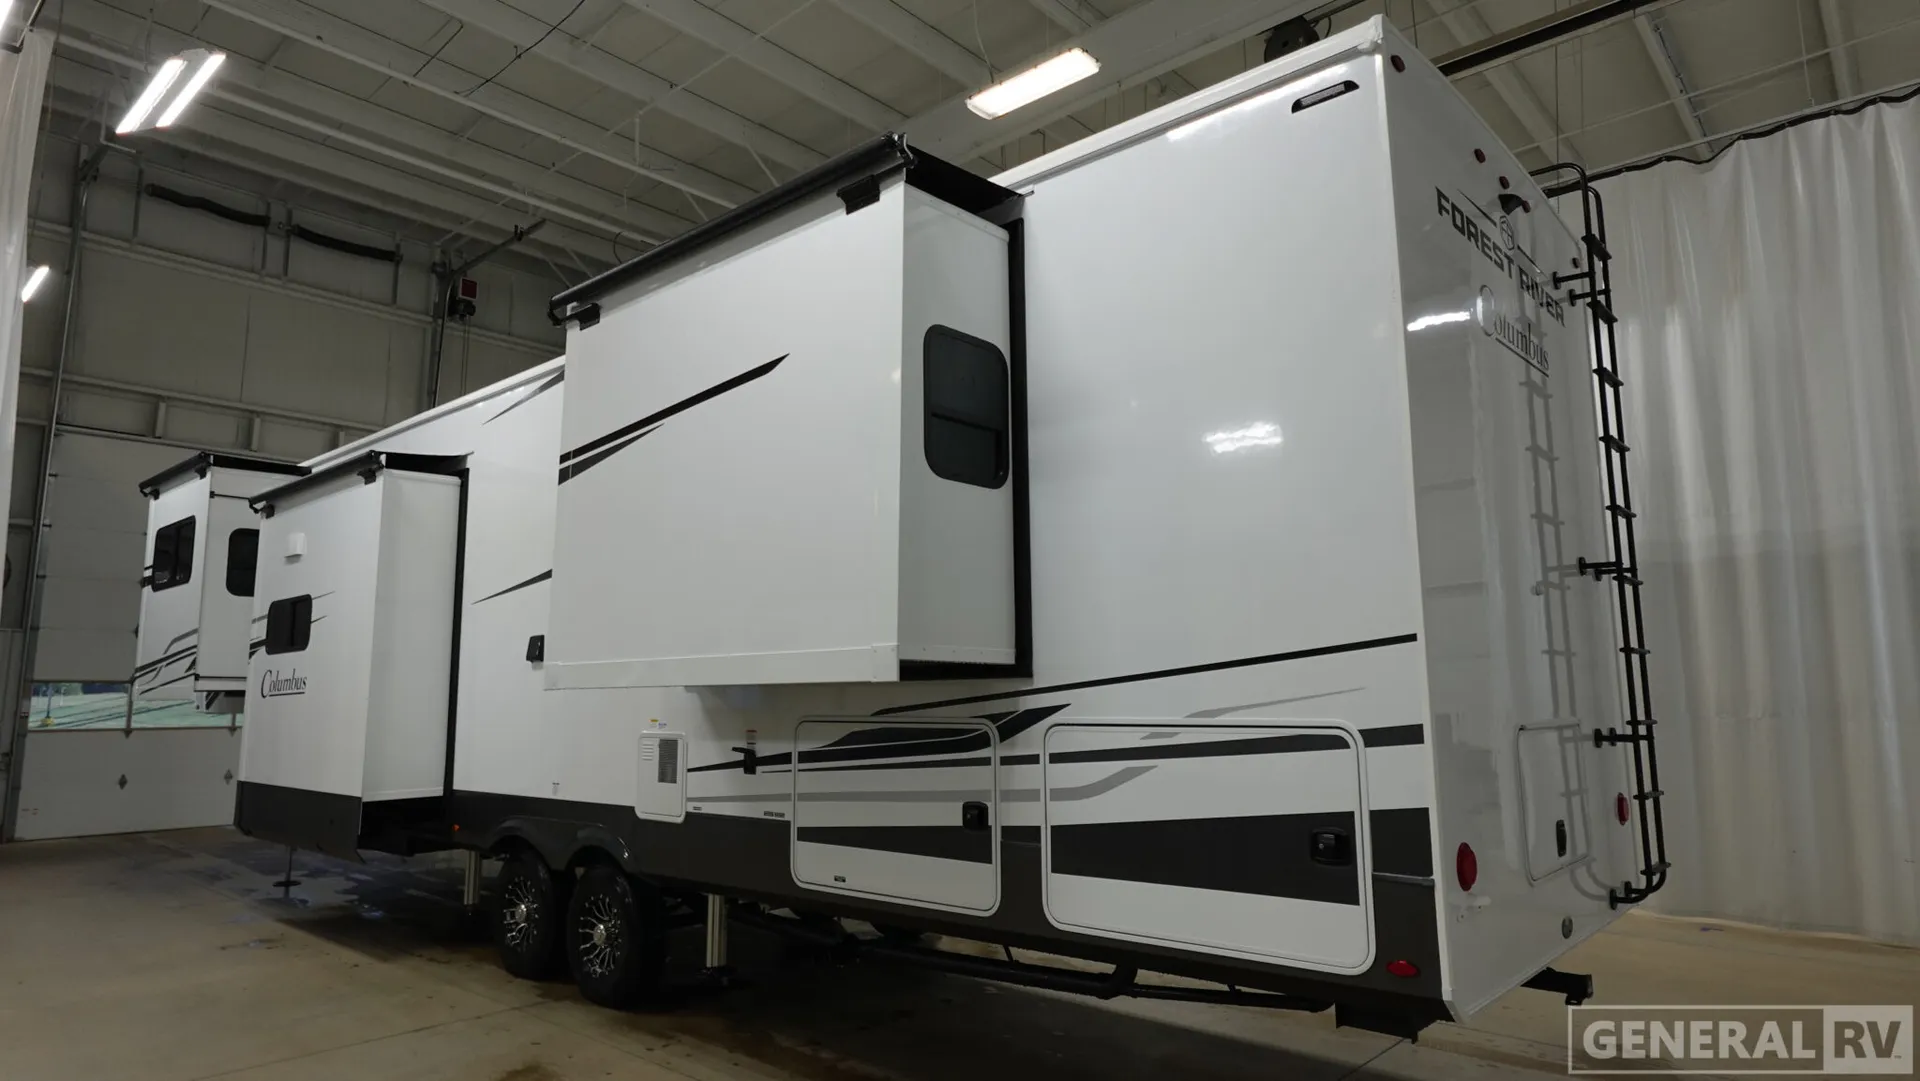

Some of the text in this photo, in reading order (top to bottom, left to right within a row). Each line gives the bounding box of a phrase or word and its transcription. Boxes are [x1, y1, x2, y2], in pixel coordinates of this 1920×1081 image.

[1436, 186, 1566, 327] FOREST RIVER
[1476, 285, 1549, 371] Columbus
[261, 668, 307, 699] Columbus
